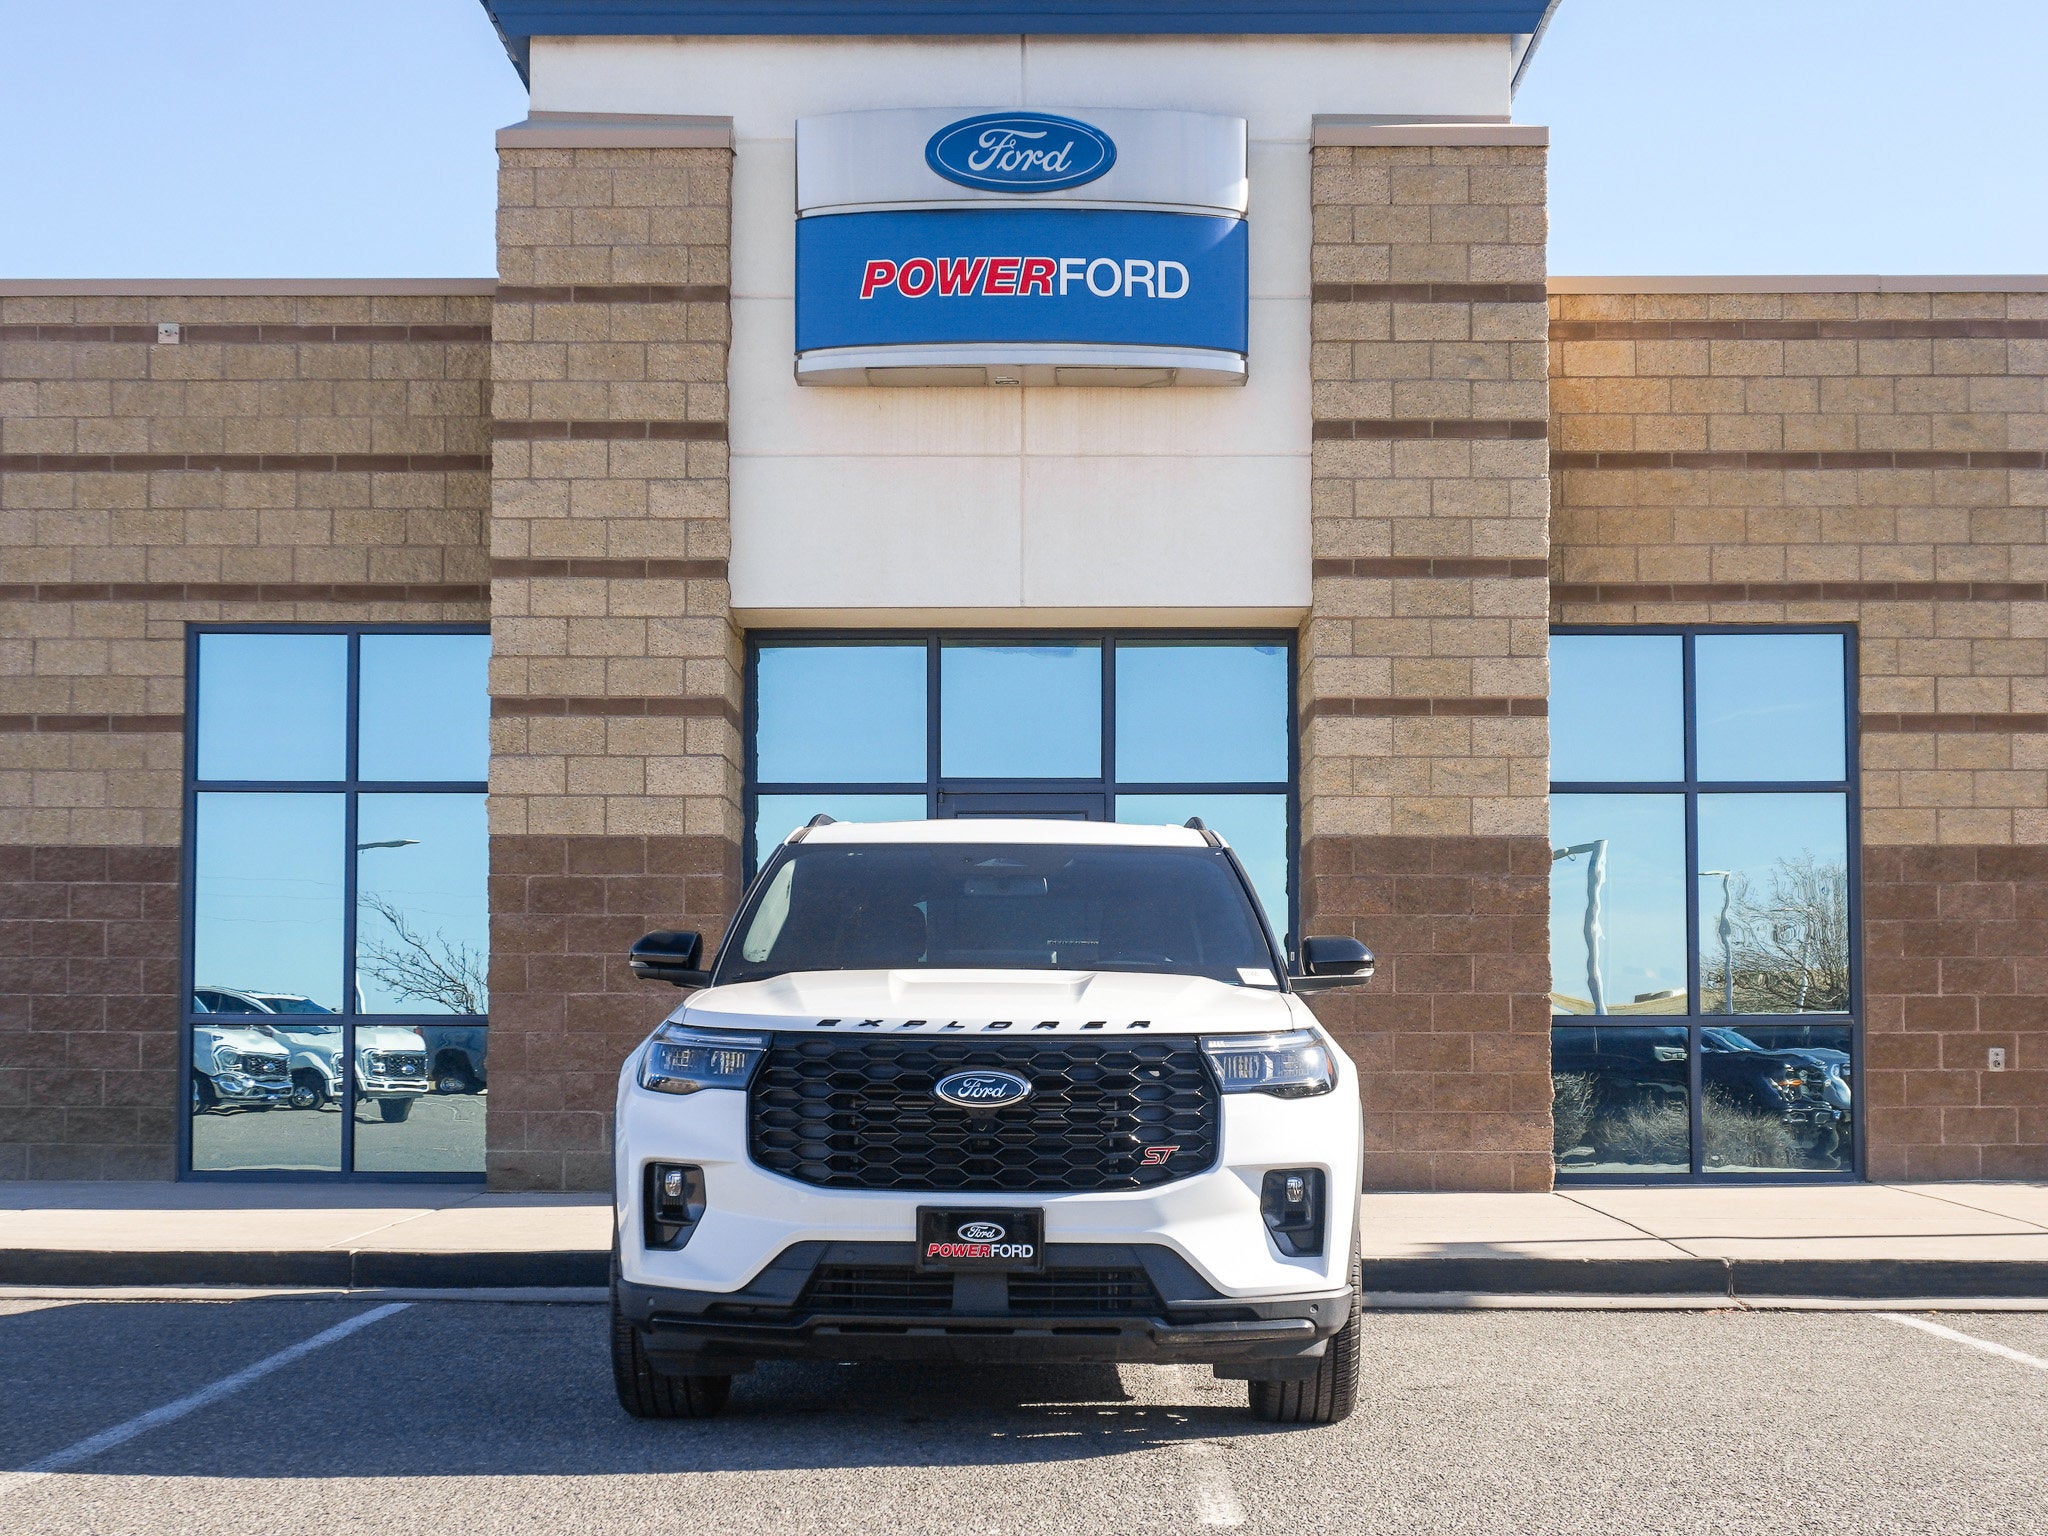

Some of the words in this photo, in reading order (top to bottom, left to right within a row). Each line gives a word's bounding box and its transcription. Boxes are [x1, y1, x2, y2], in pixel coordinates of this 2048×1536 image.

[967, 128, 1074, 174] Ford
[816, 1018, 1151, 1030] EXPLORER
[957, 1077, 1008, 1100] Ford
[1140, 1144, 1180, 1166] ST
[967, 1225, 996, 1239] Ford
